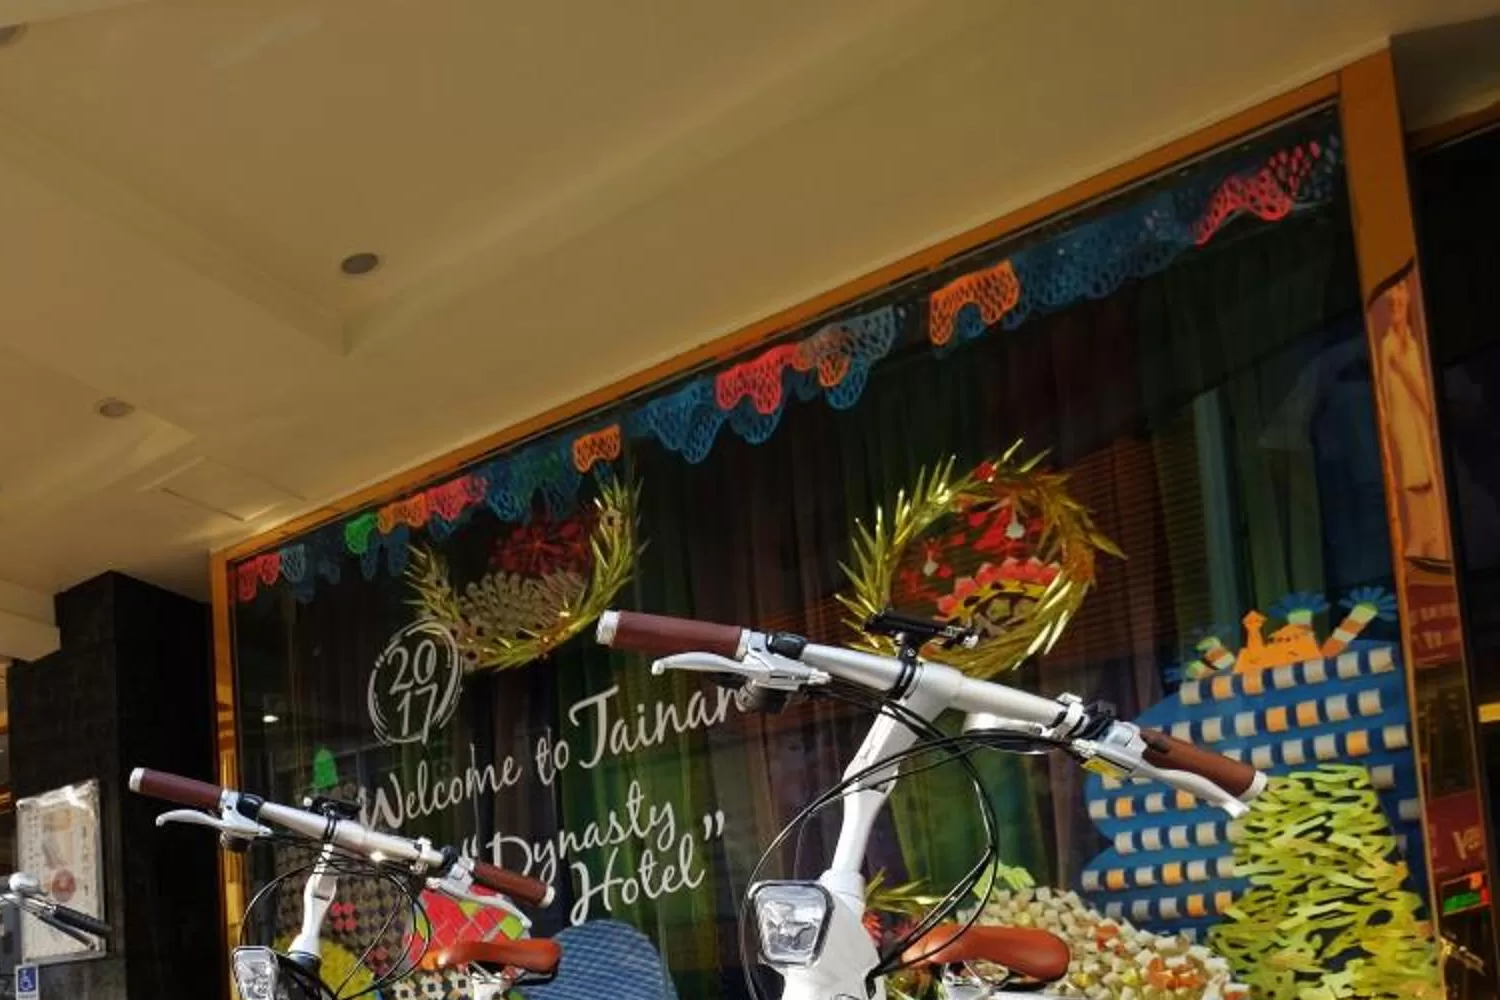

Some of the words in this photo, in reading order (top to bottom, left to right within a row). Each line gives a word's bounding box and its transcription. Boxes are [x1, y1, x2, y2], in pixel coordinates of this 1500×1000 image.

[386, 638, 438, 694] 20
[396, 682, 439, 745] 17
[356, 755, 523, 829] Welcome
[535, 737, 570, 787] to
